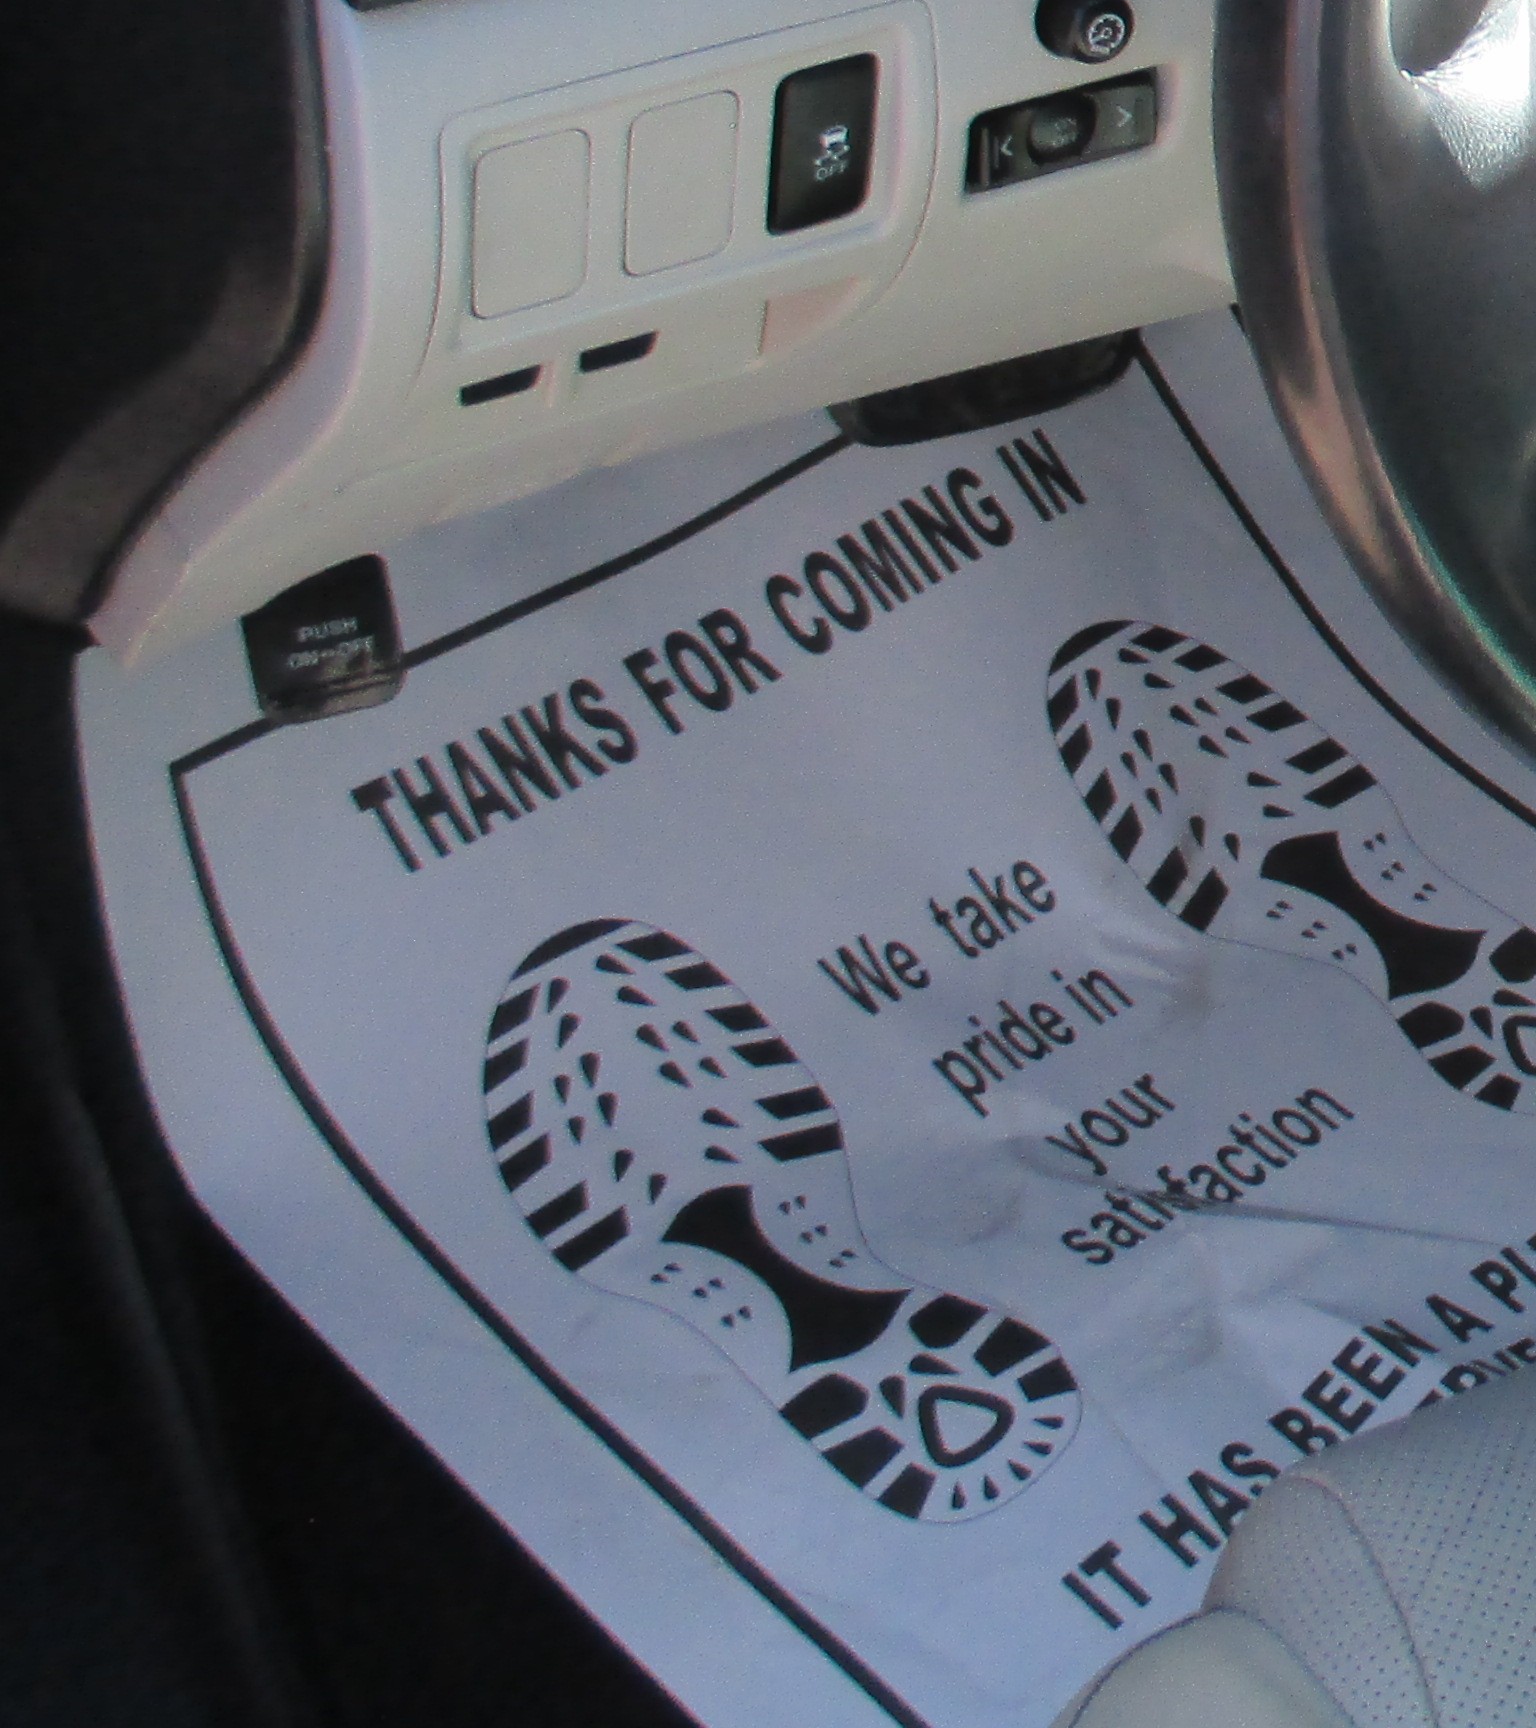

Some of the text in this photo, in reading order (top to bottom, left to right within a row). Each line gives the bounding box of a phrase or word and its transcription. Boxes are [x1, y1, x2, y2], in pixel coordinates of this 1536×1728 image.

[350, 427, 1088, 873] THANKS FOR COMING IN
[816, 854, 1057, 1017] We take
[931, 962, 1134, 1119] pride in
[1044, 1073, 1176, 1177] your
[1060, 1088, 1355, 1266] satifaction
[1061, 1540, 1153, 1631] IT
[1138, 1441, 1282, 1569] HAS
[1267, 1318, 1440, 1459] BEEN
[1425, 1294, 1493, 1344] A
